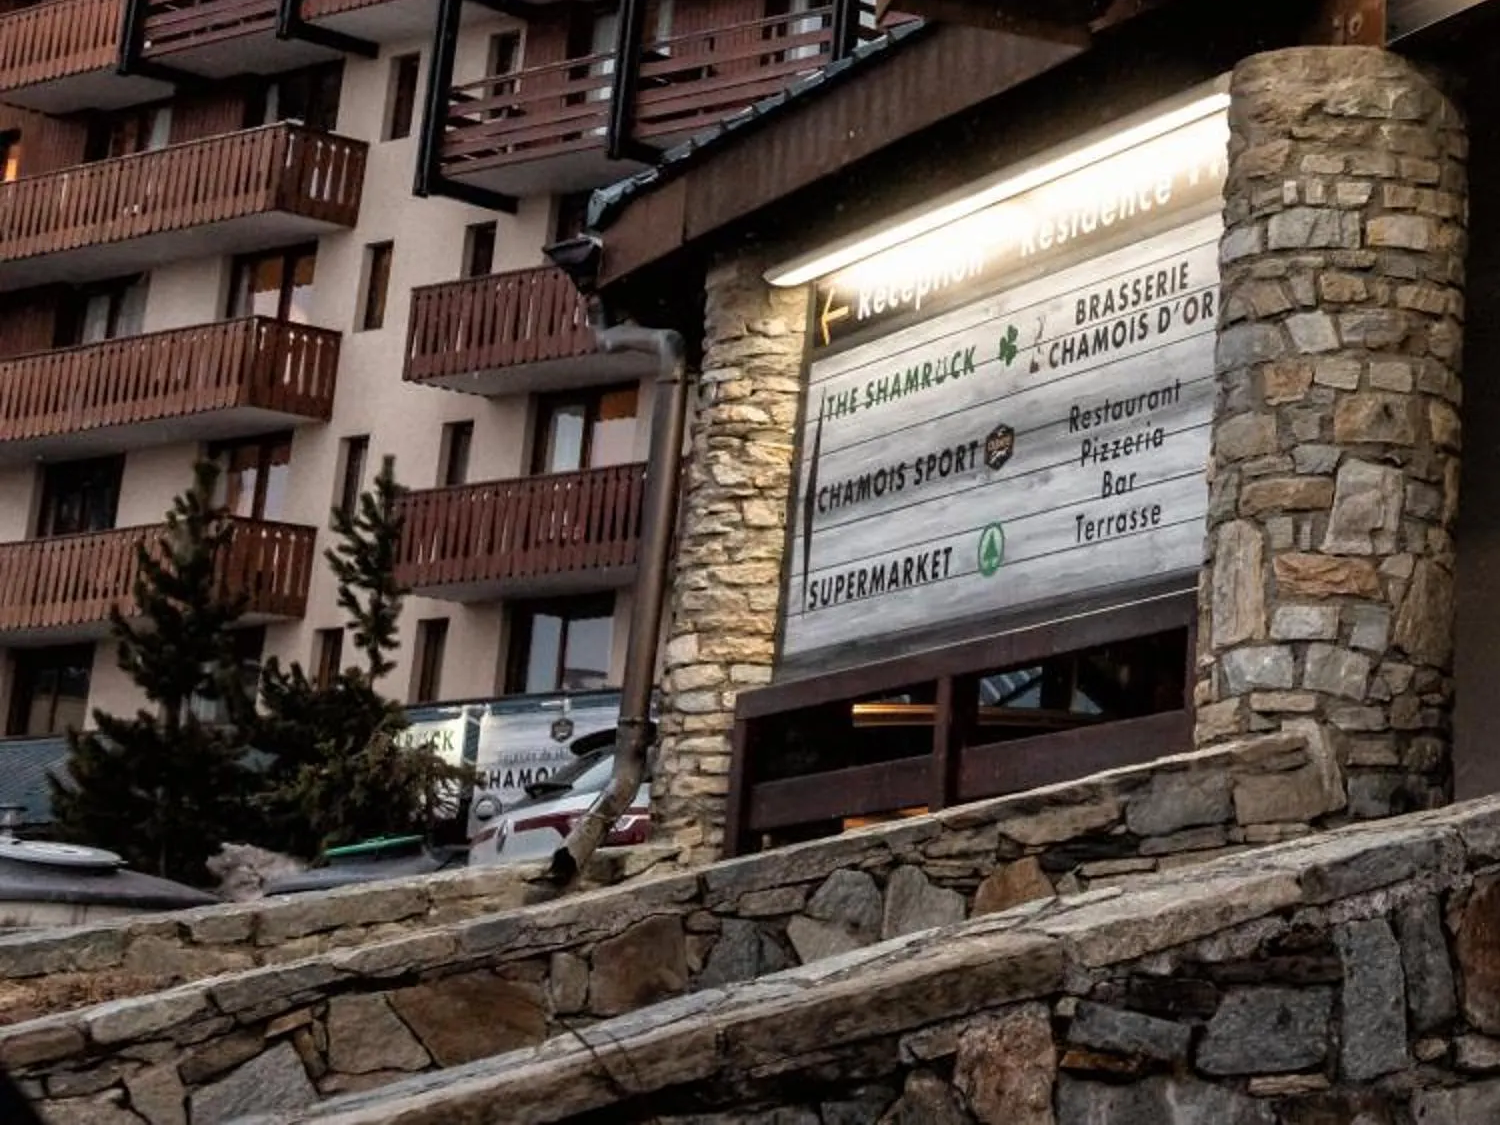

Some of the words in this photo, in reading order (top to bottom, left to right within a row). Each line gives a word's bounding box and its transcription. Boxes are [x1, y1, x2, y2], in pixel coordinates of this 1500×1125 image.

[1075, 261, 1189, 325] BRASSERIE
[1049, 312, 1149, 369] CHAMOIS
[1157, 291, 1214, 334] D'OR
[827, 386, 858, 421] THE
[1069, 379, 1182, 433] Restaurant
[1080, 421, 1165, 467] Pizzeria
[818, 462, 906, 514] CHAMOIS
[914, 441, 979, 485] SPORT
[1102, 470, 1137, 499] Bar
[1075, 504, 1161, 543] Terrasse
[808, 547, 953, 610] SUPERMARKET
